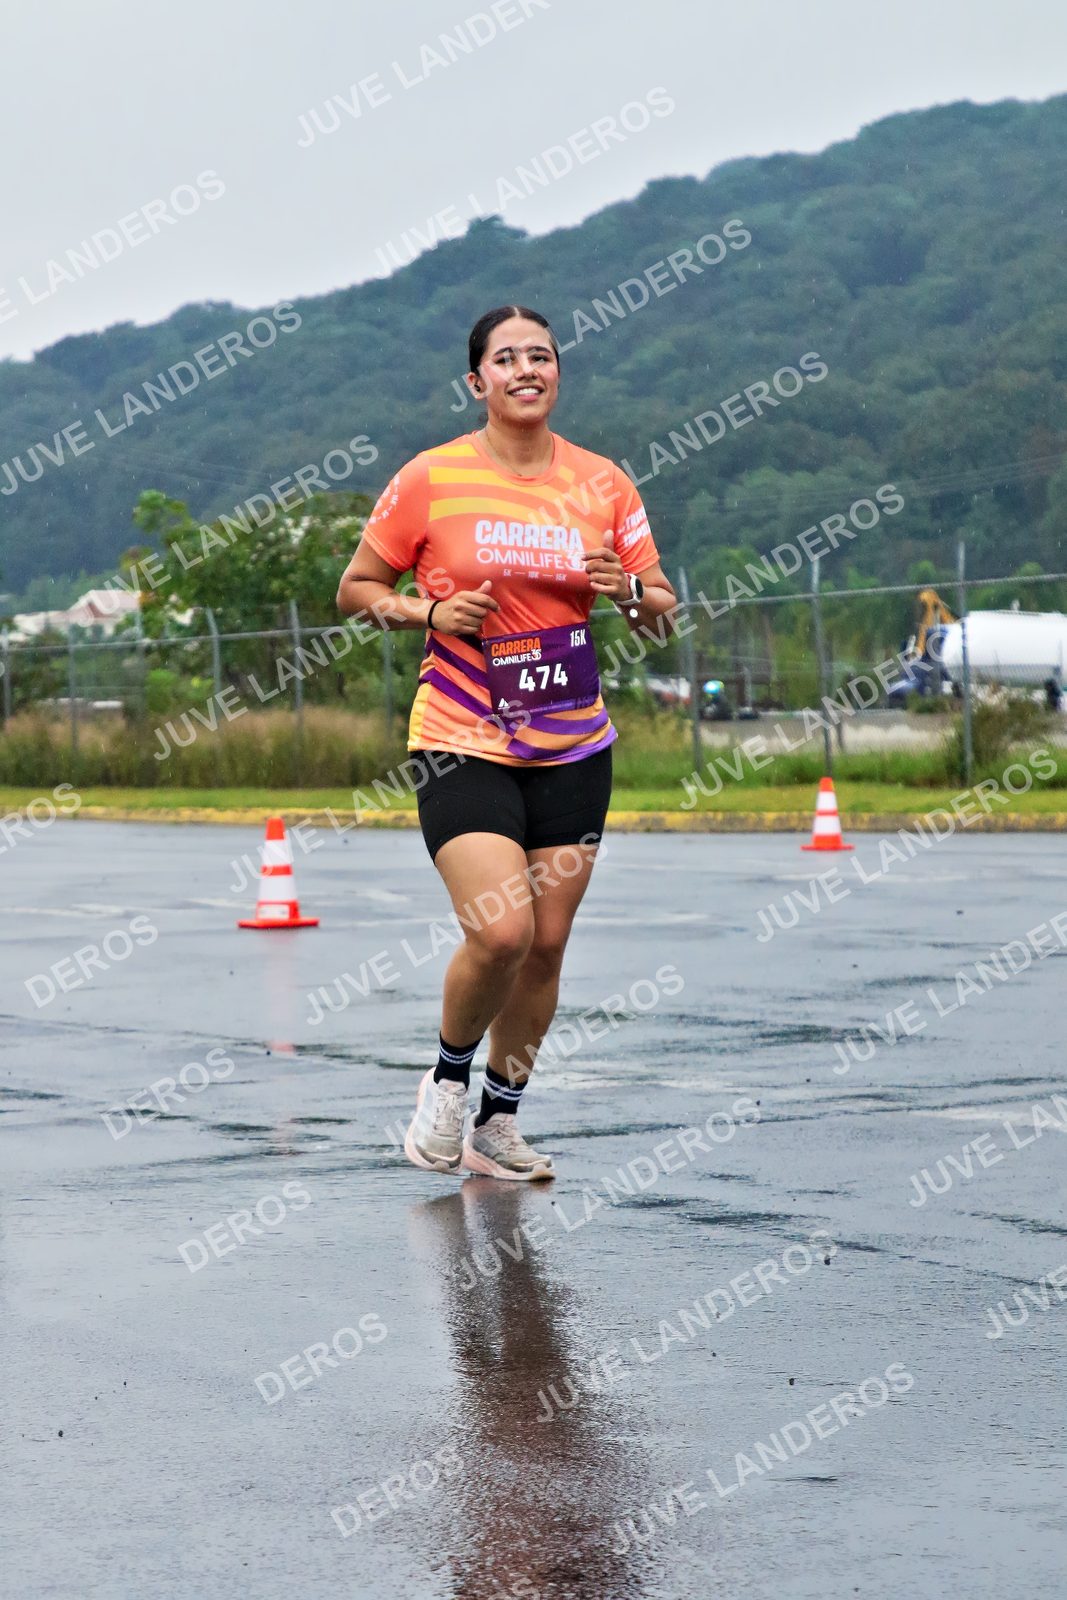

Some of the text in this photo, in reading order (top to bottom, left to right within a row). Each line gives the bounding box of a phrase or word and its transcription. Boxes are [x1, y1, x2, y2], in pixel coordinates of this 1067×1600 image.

[475, 519, 584, 552] CARRERA
[491, 637, 541, 657] CARRERA
[569, 629, 587, 647] 15K
[519, 663, 568, 691] 474
